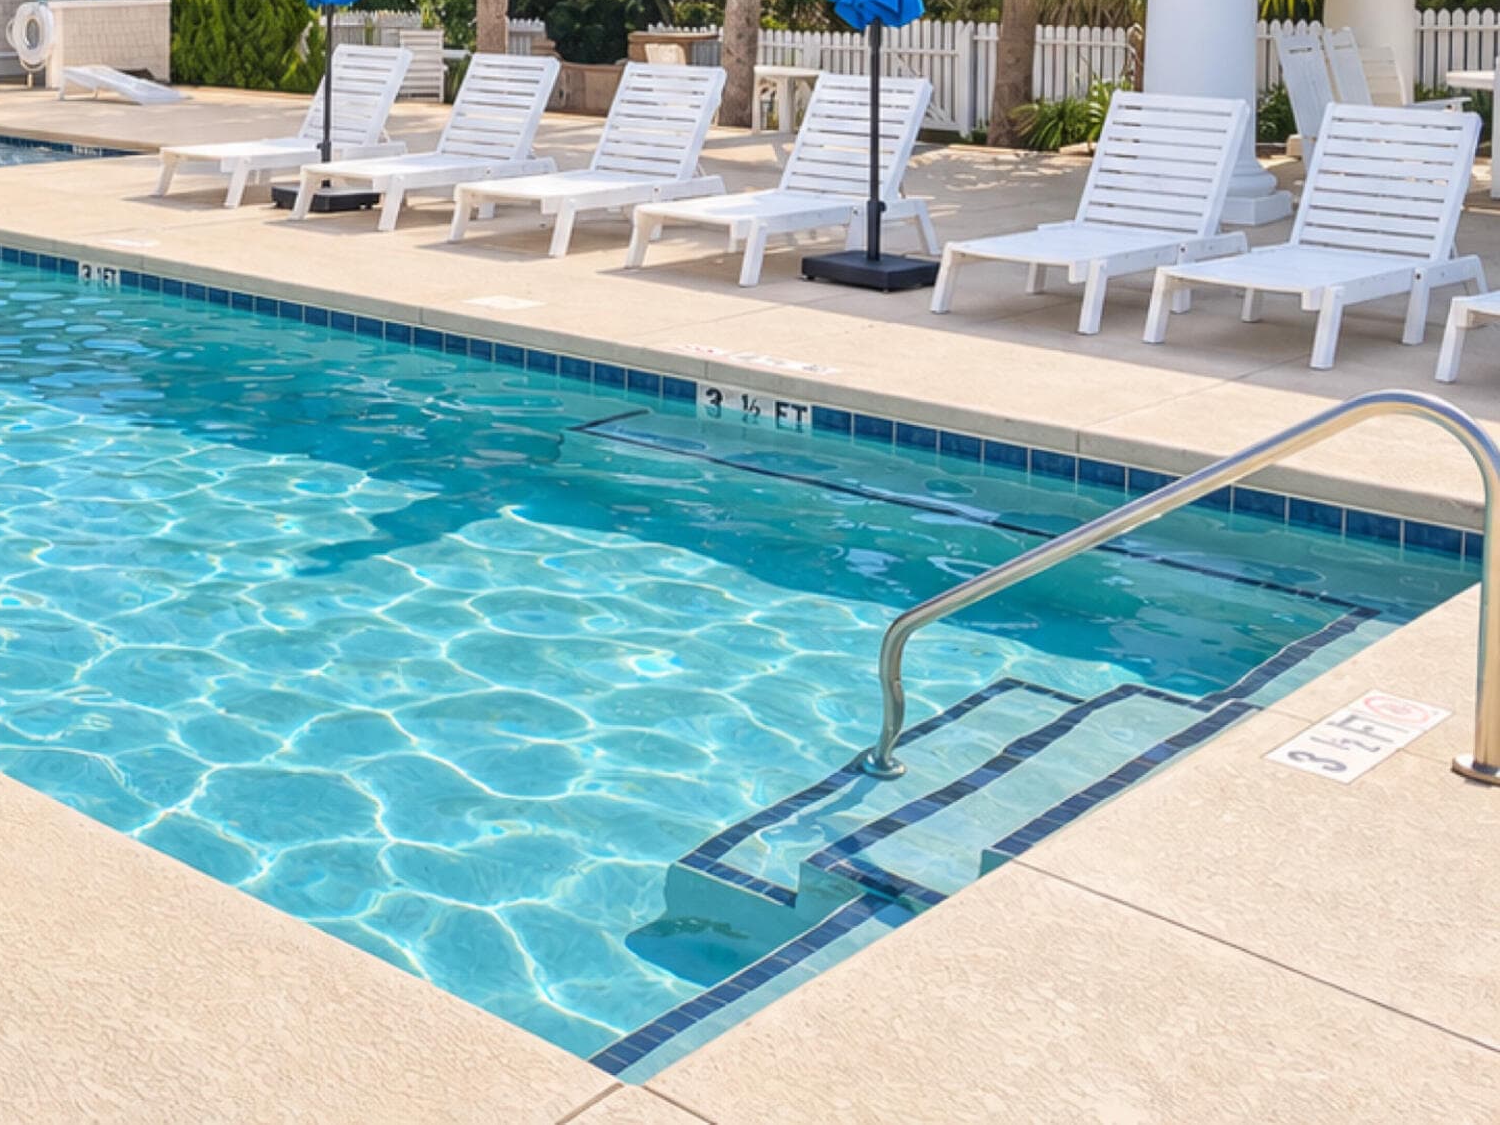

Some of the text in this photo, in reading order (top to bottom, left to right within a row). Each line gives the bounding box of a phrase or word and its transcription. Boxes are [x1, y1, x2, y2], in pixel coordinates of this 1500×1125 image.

[706, 387, 723, 418] 3
[776, 401, 808, 432] FT
[1287, 749, 1348, 772] 3
[1325, 713, 1410, 744] FT
